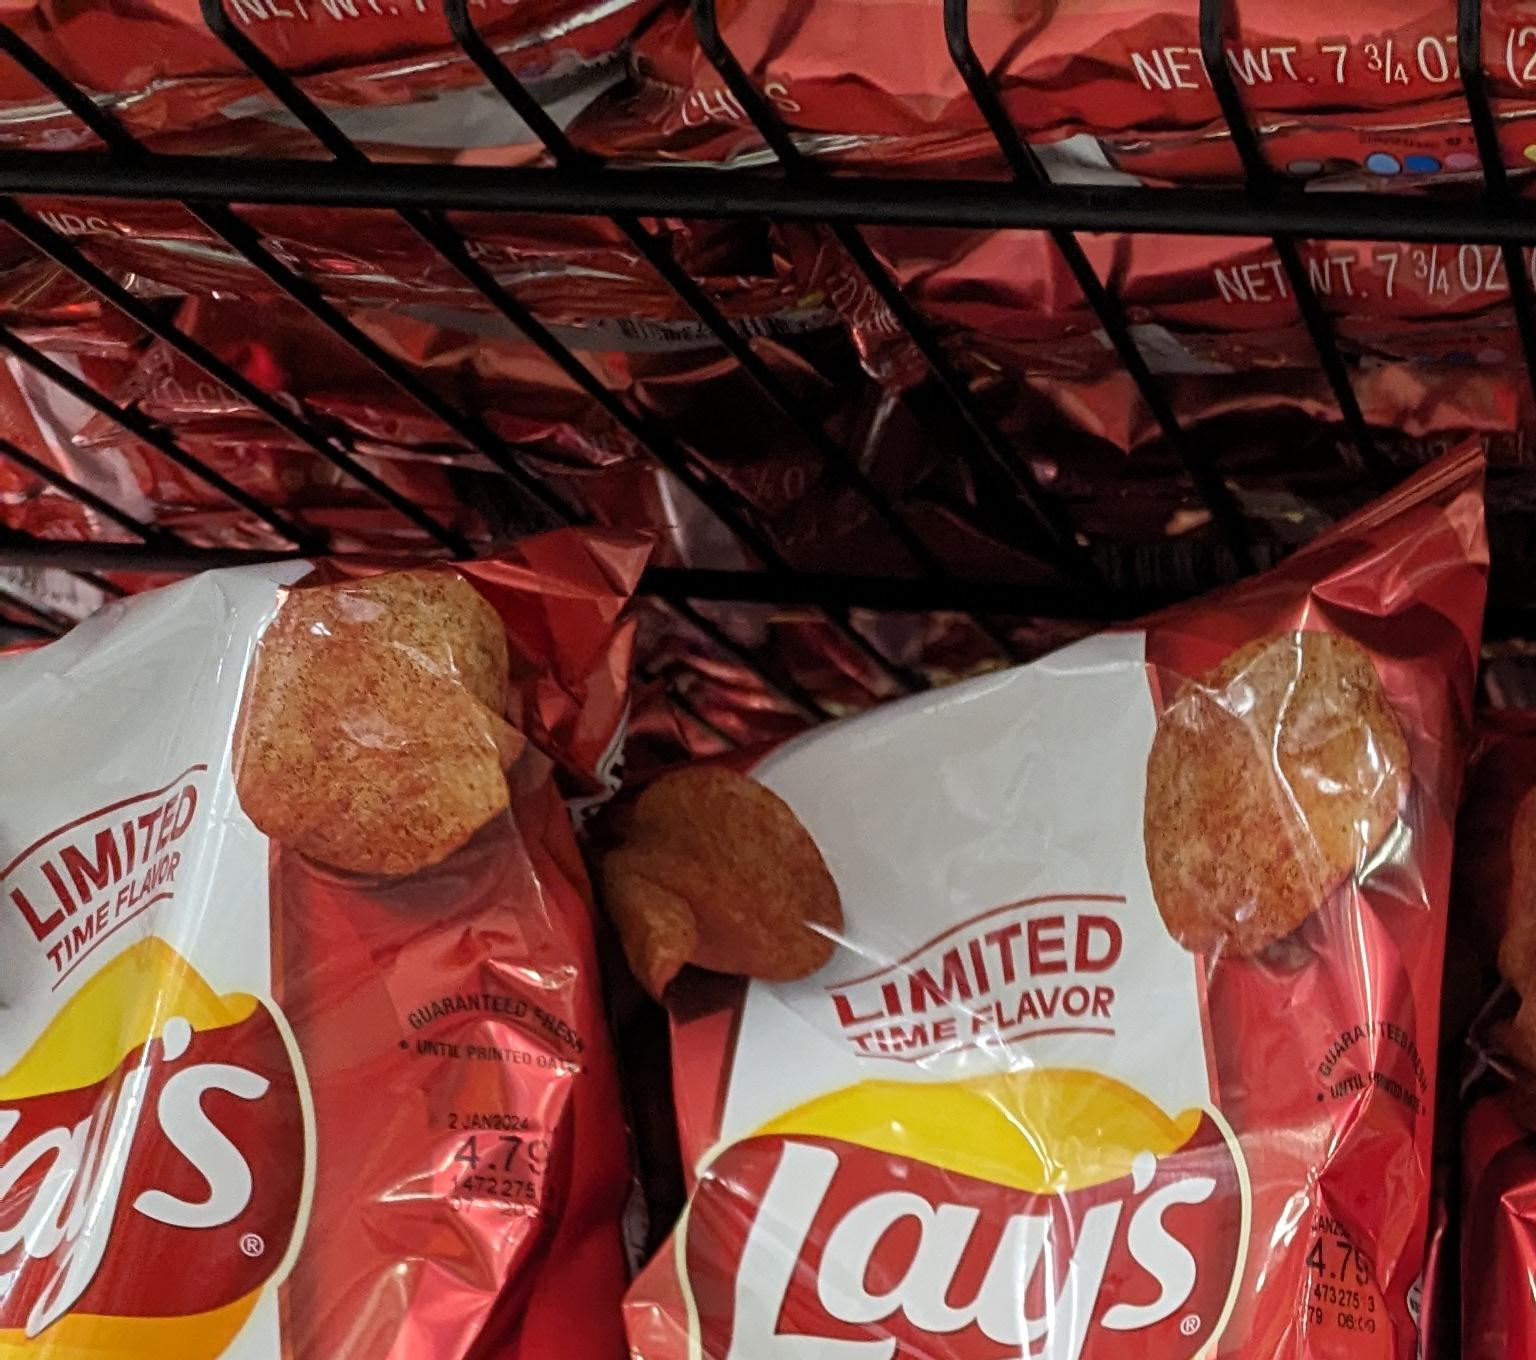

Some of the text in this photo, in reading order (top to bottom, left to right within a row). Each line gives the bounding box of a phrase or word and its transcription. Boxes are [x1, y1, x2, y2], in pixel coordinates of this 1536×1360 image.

[1321, 44, 1348, 84] 7
[680, 82, 801, 127] CHIS
[1375, 253, 1398, 298] 7
[9, 783, 199, 944] LIMITED
[46, 849, 182, 974] TIME FLAVOR
[831, 914, 1124, 1030] LIMITED
[407, 992, 528, 1031] GUARANTEED
[847, 985, 1117, 1054] TIME FLAVOR
